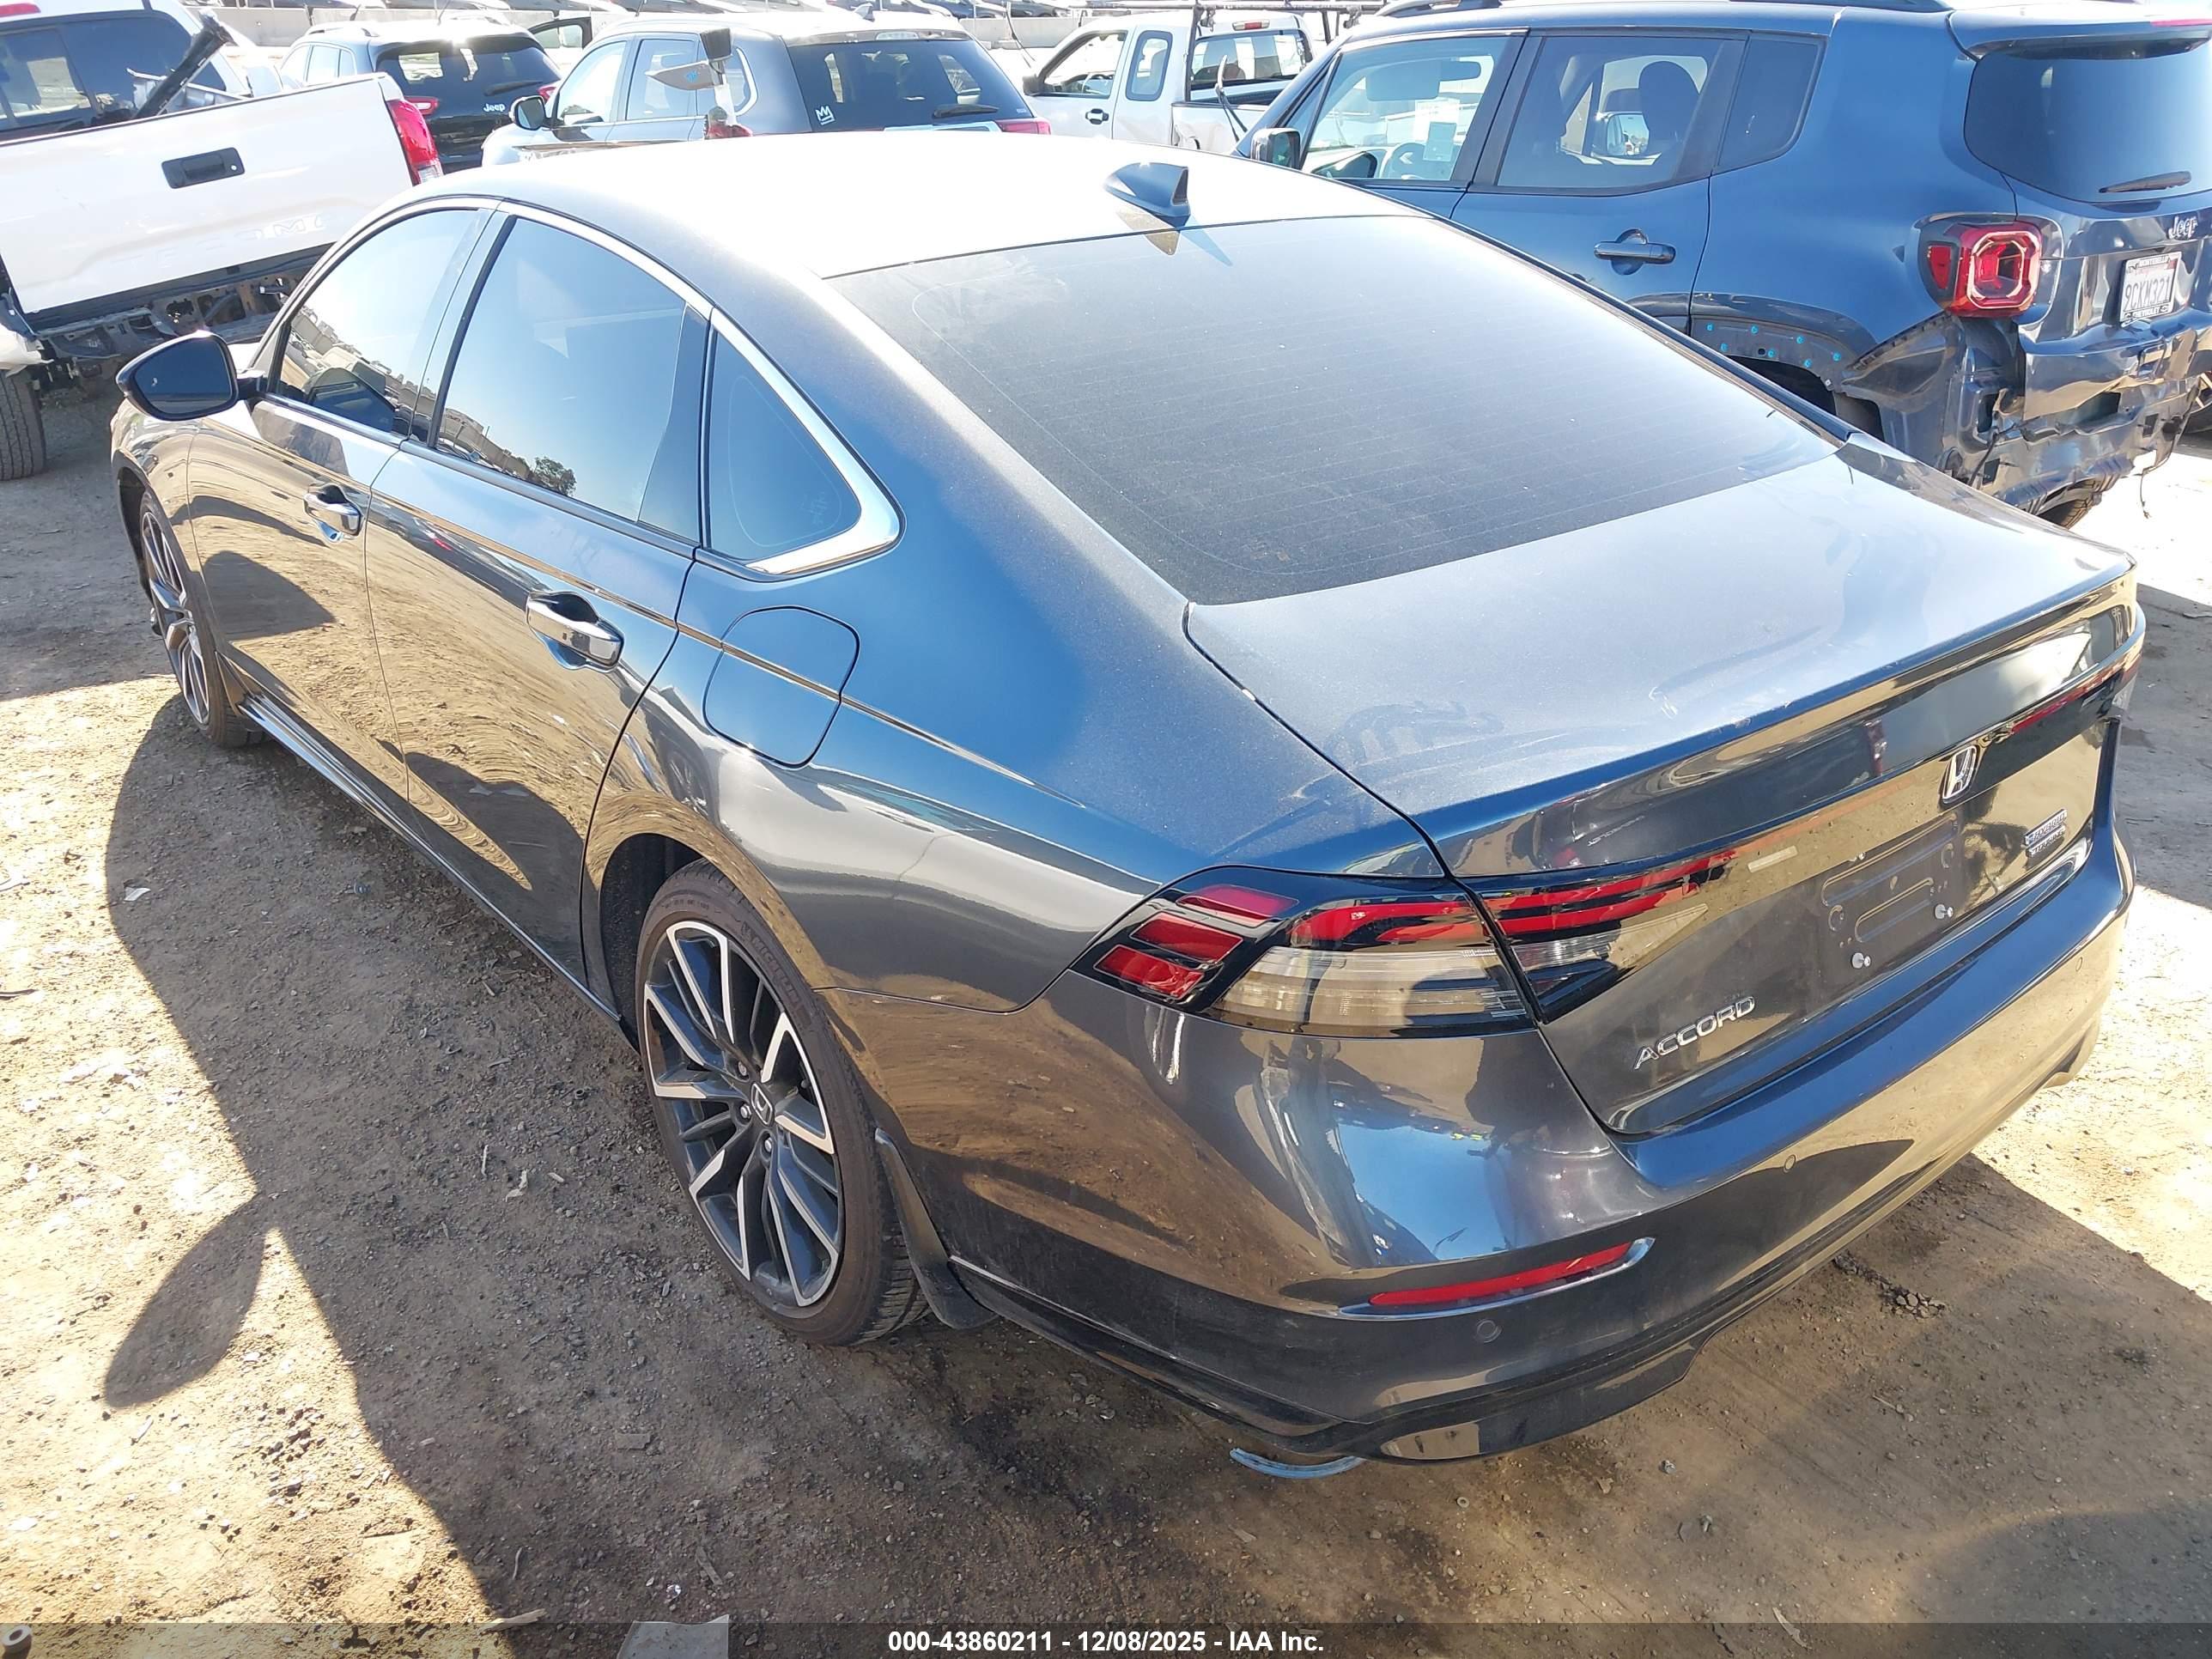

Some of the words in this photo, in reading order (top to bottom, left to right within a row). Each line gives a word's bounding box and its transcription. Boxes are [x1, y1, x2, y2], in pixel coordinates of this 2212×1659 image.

[483, 103, 506, 112] Jeep
[2168, 216, 2198, 239] Jeep
[2032, 811, 2067, 842] HYBRID
[1633, 996, 1756, 1070] ACCORD
